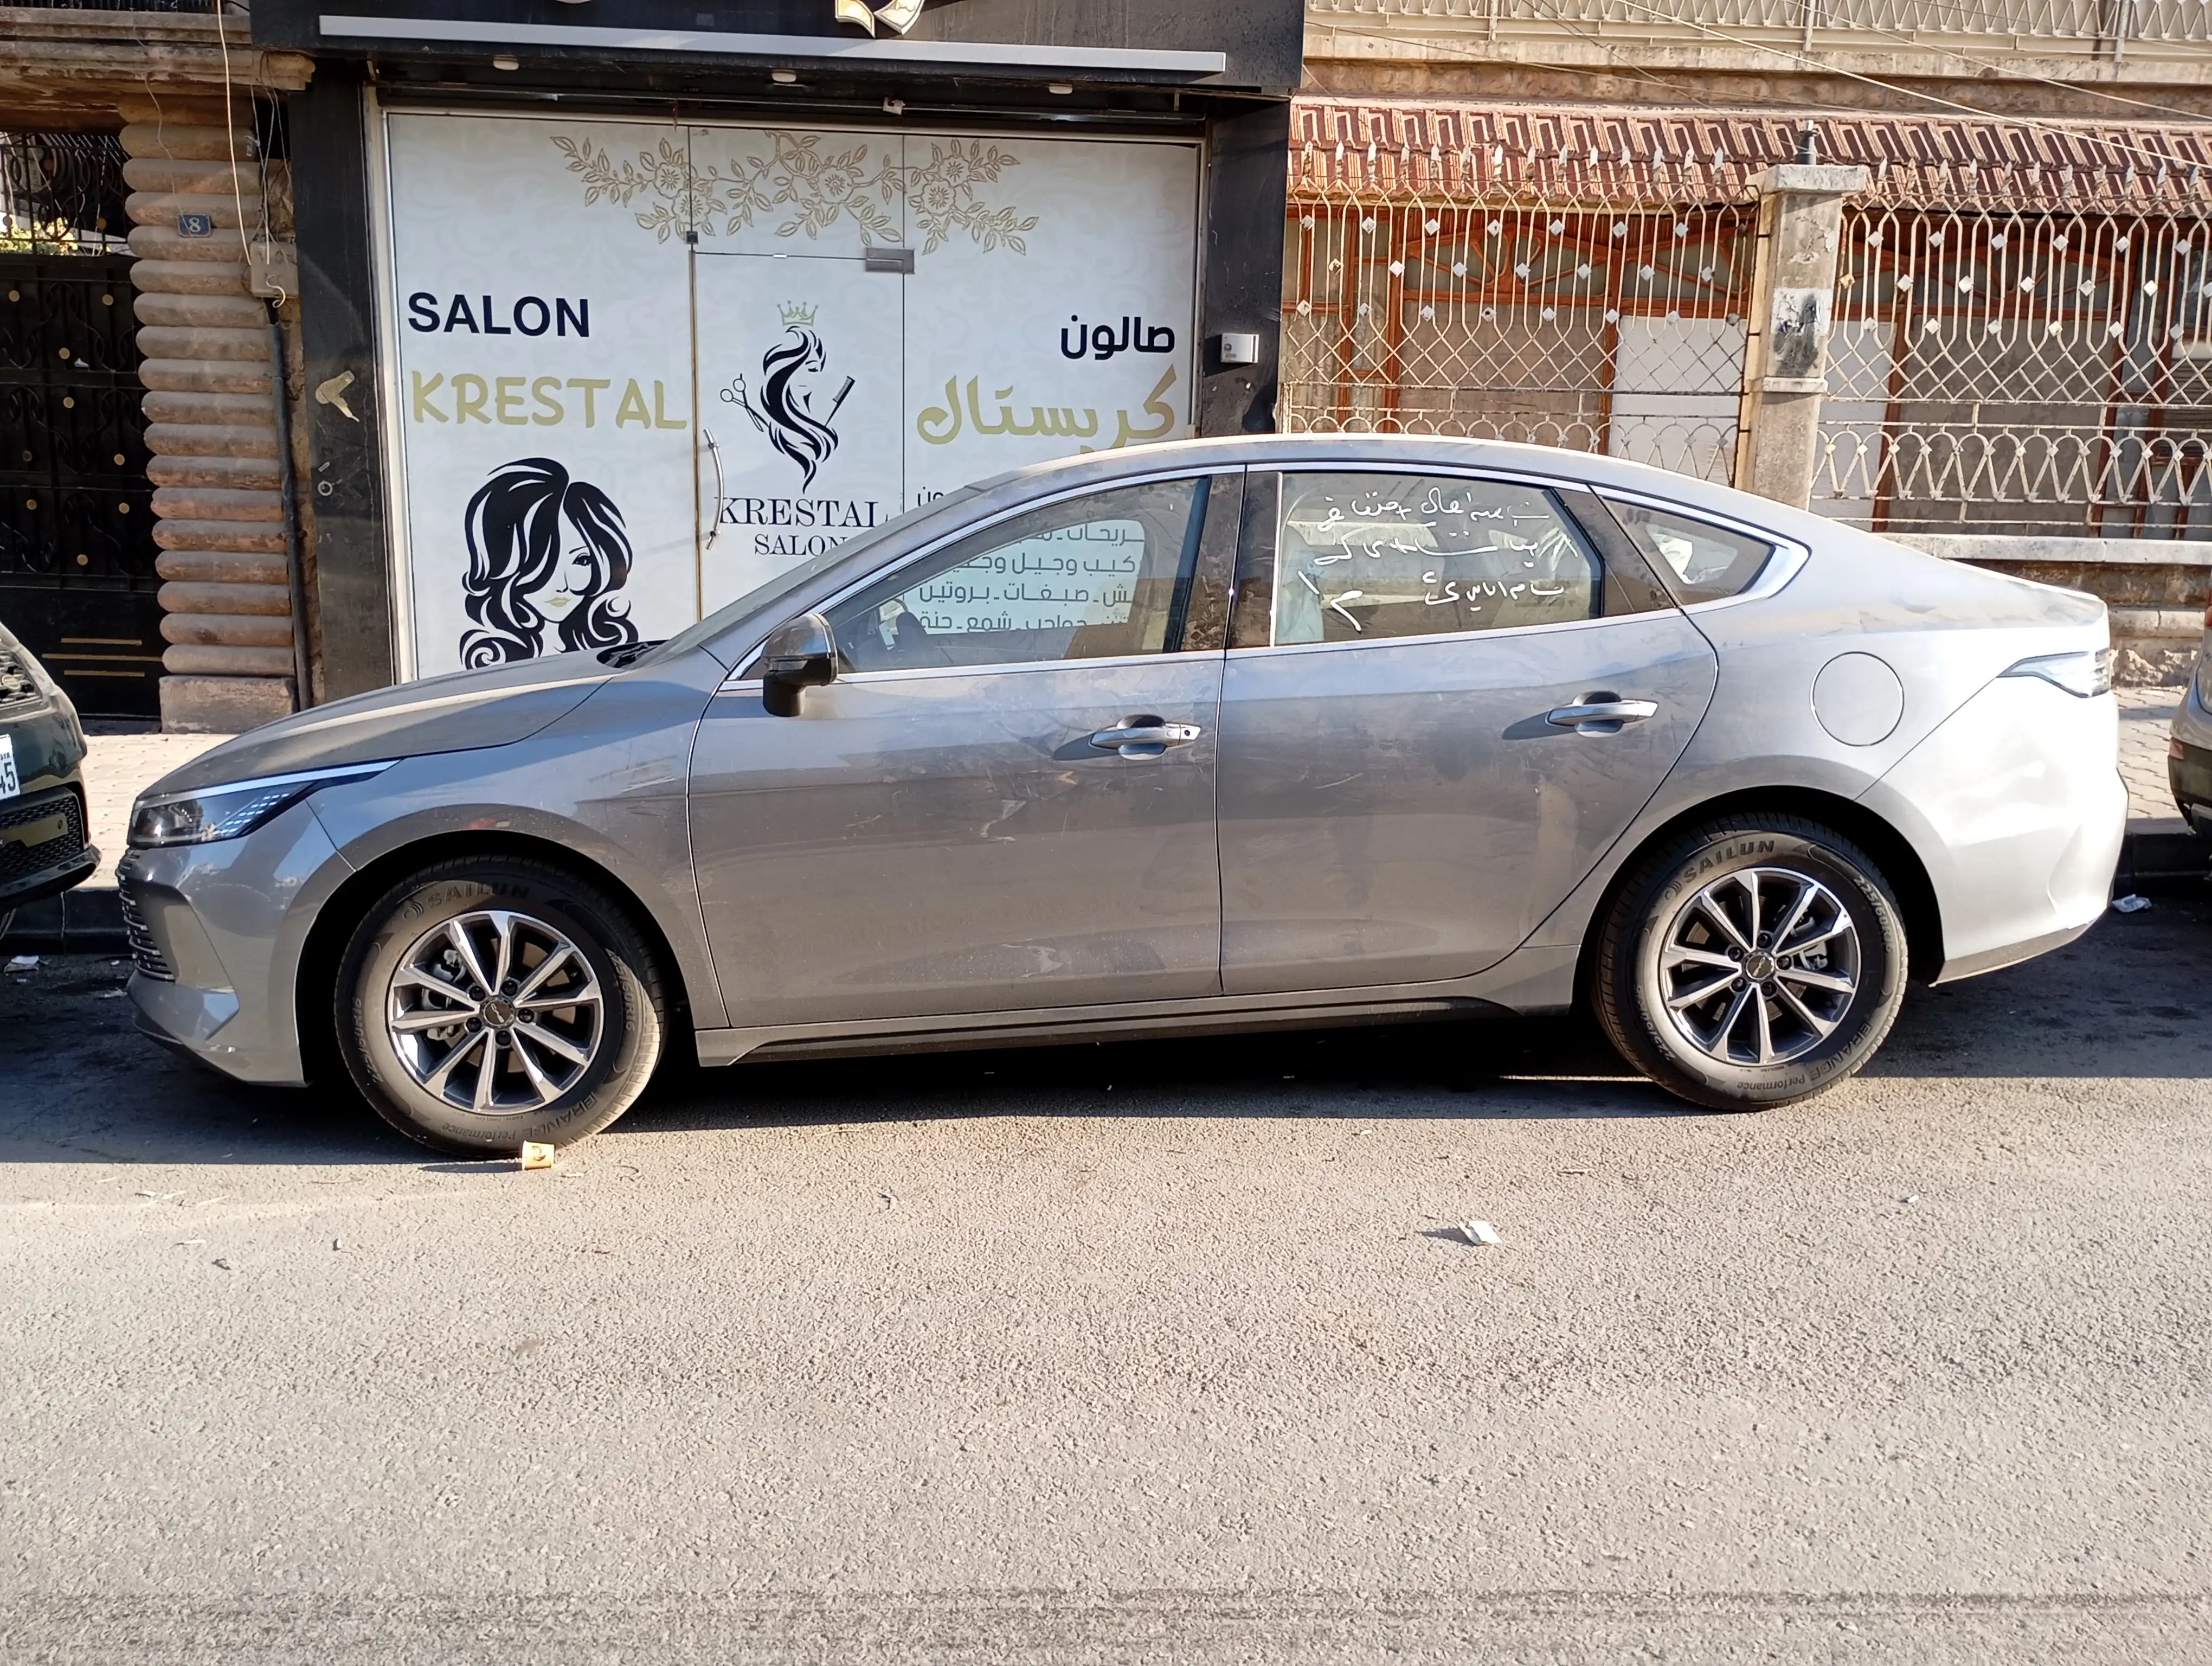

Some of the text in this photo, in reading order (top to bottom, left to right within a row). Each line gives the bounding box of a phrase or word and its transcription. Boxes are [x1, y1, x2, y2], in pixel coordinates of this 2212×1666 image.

[189, 217, 201, 232] 8
[408, 292, 590, 337] SALON
[1061, 315, 1175, 360] صالون
[411, 370, 687, 430] KRESTAL
[917, 363, 1177, 453] كريستال
[714, 497, 889, 528] KRESTAL
[1012, 552, 1077, 575] وجيل
[1084, 556, 1137, 576] كيب
[919, 581, 989, 604] بروتين
[1004, 582, 1089, 606] صبغات
[1683, 840, 1775, 883] SAILUN
[426, 882, 530, 909] SAILUN
[1737, 1074, 1805, 1091] Performance
[440, 1123, 516, 1140] Performance
